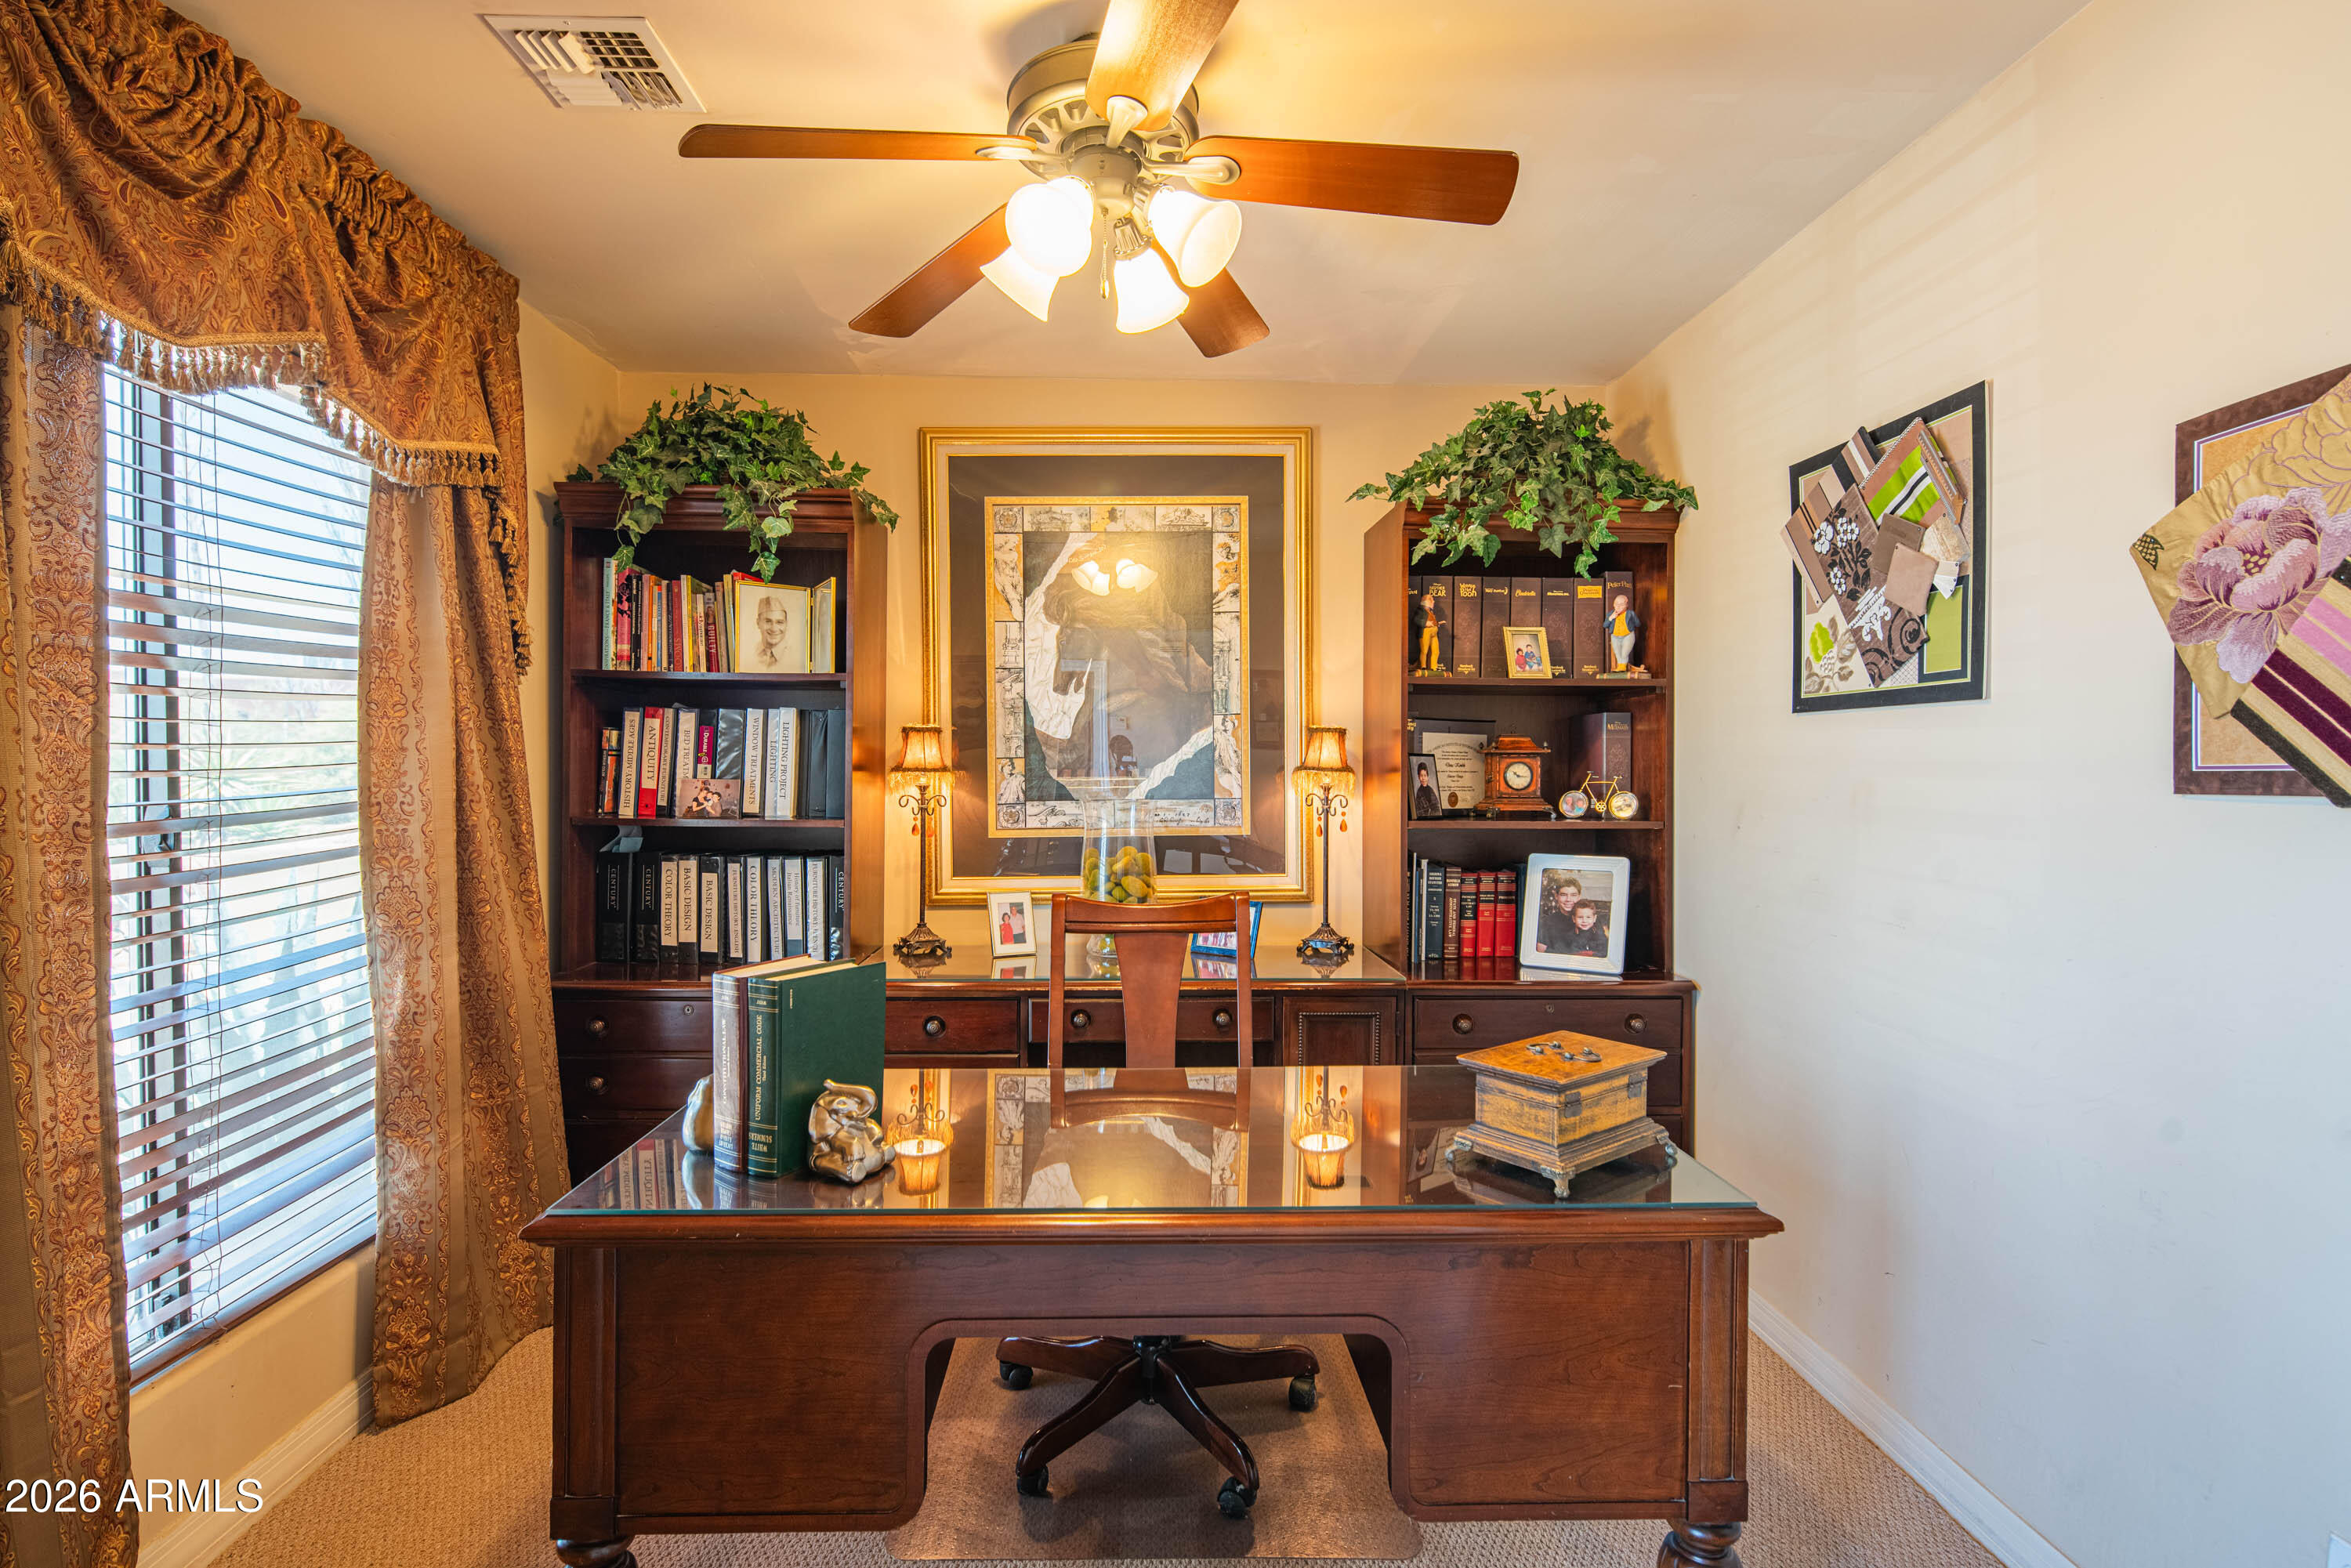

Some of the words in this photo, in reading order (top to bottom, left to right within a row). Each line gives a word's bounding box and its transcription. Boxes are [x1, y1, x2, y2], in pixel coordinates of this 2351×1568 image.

[708, 625, 716, 653] GUILTY
[646, 726, 657, 780] ANTIQUITY
[661, 716, 670, 766] CONTEMPORARY
[781, 722, 790, 762] LIGHTING
[623, 770, 632, 809] HISTORY:
[748, 754, 758, 805] TREATMENTS
[749, 866, 758, 900] COLOR
[664, 901, 672, 937] THEORY
[748, 1132, 772, 1144] SUMMERS
[752, 1142, 768, 1152] WHITE
